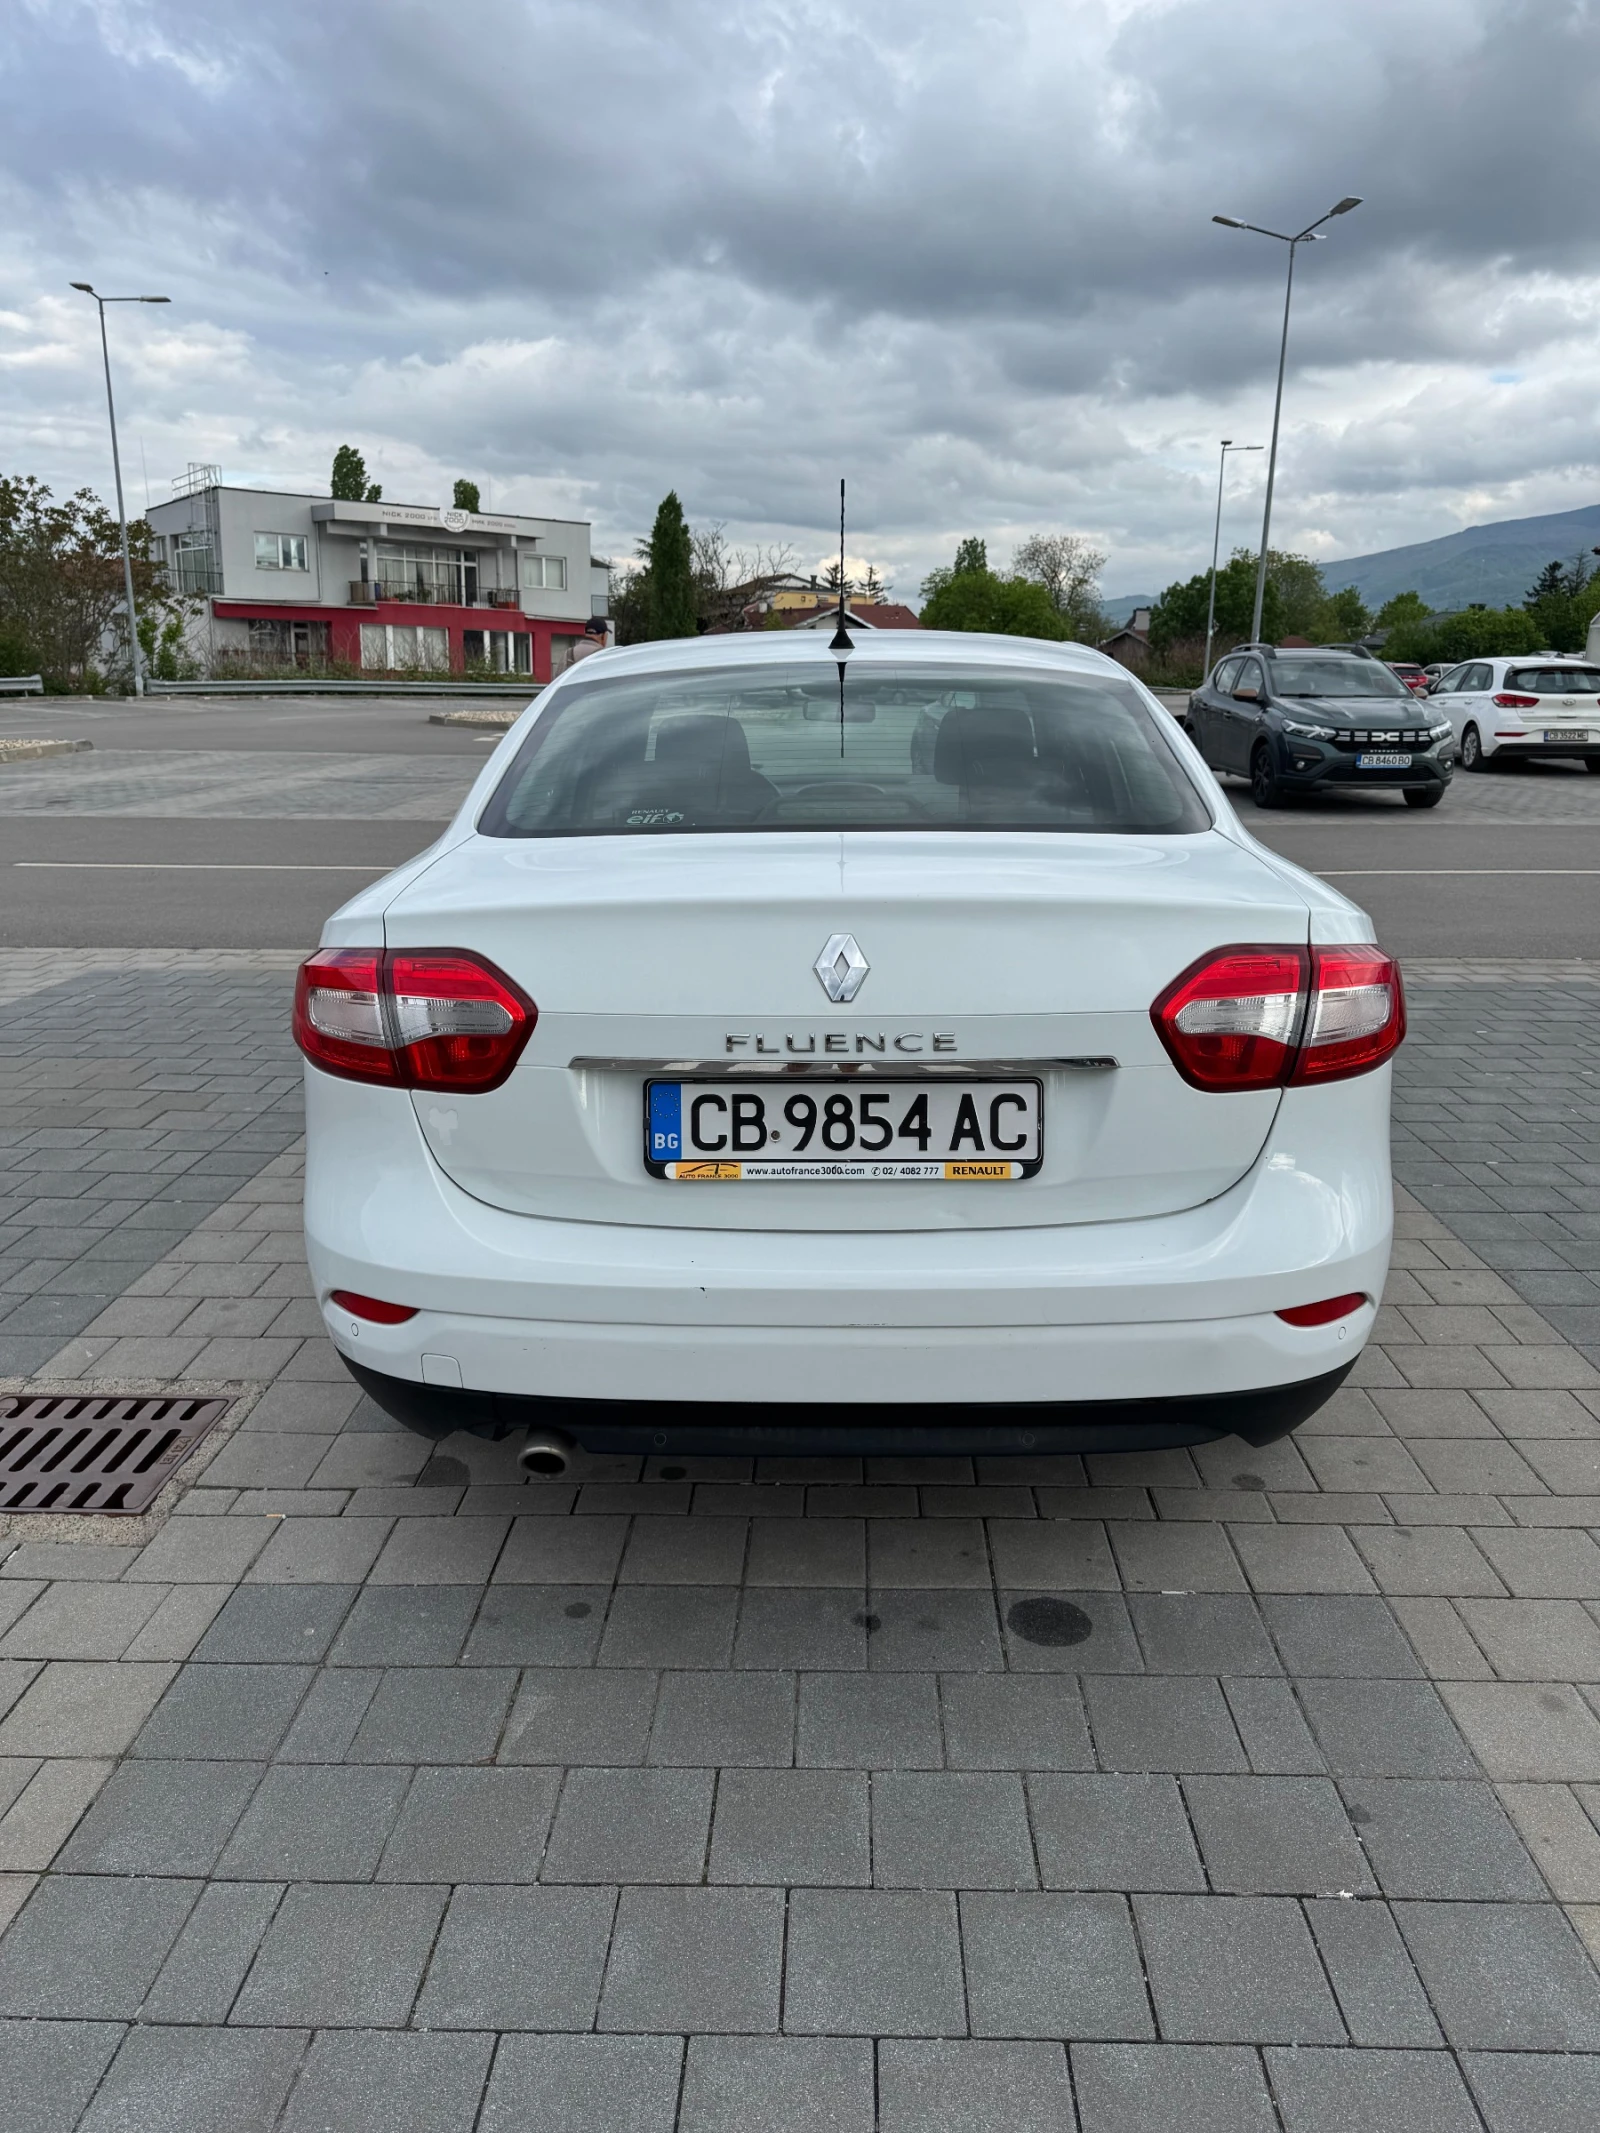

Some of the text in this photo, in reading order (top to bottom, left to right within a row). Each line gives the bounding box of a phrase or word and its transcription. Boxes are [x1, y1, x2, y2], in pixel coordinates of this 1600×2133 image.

[1362, 756, 1374, 765] CB
[1375, 756, 1397, 765] 8460
[725, 1032, 958, 1053] FLUENCE
[690, 1093, 1028, 1152] CB 9854 AC
[654, 1132, 679, 1150] BG
[746, 1166, 865, 1176] www.autofrance3000.com
[900, 1167, 921, 1176] 4082
[923, 1167, 939, 1175] 777
[952, 1166, 1006, 1175] RENAULT
